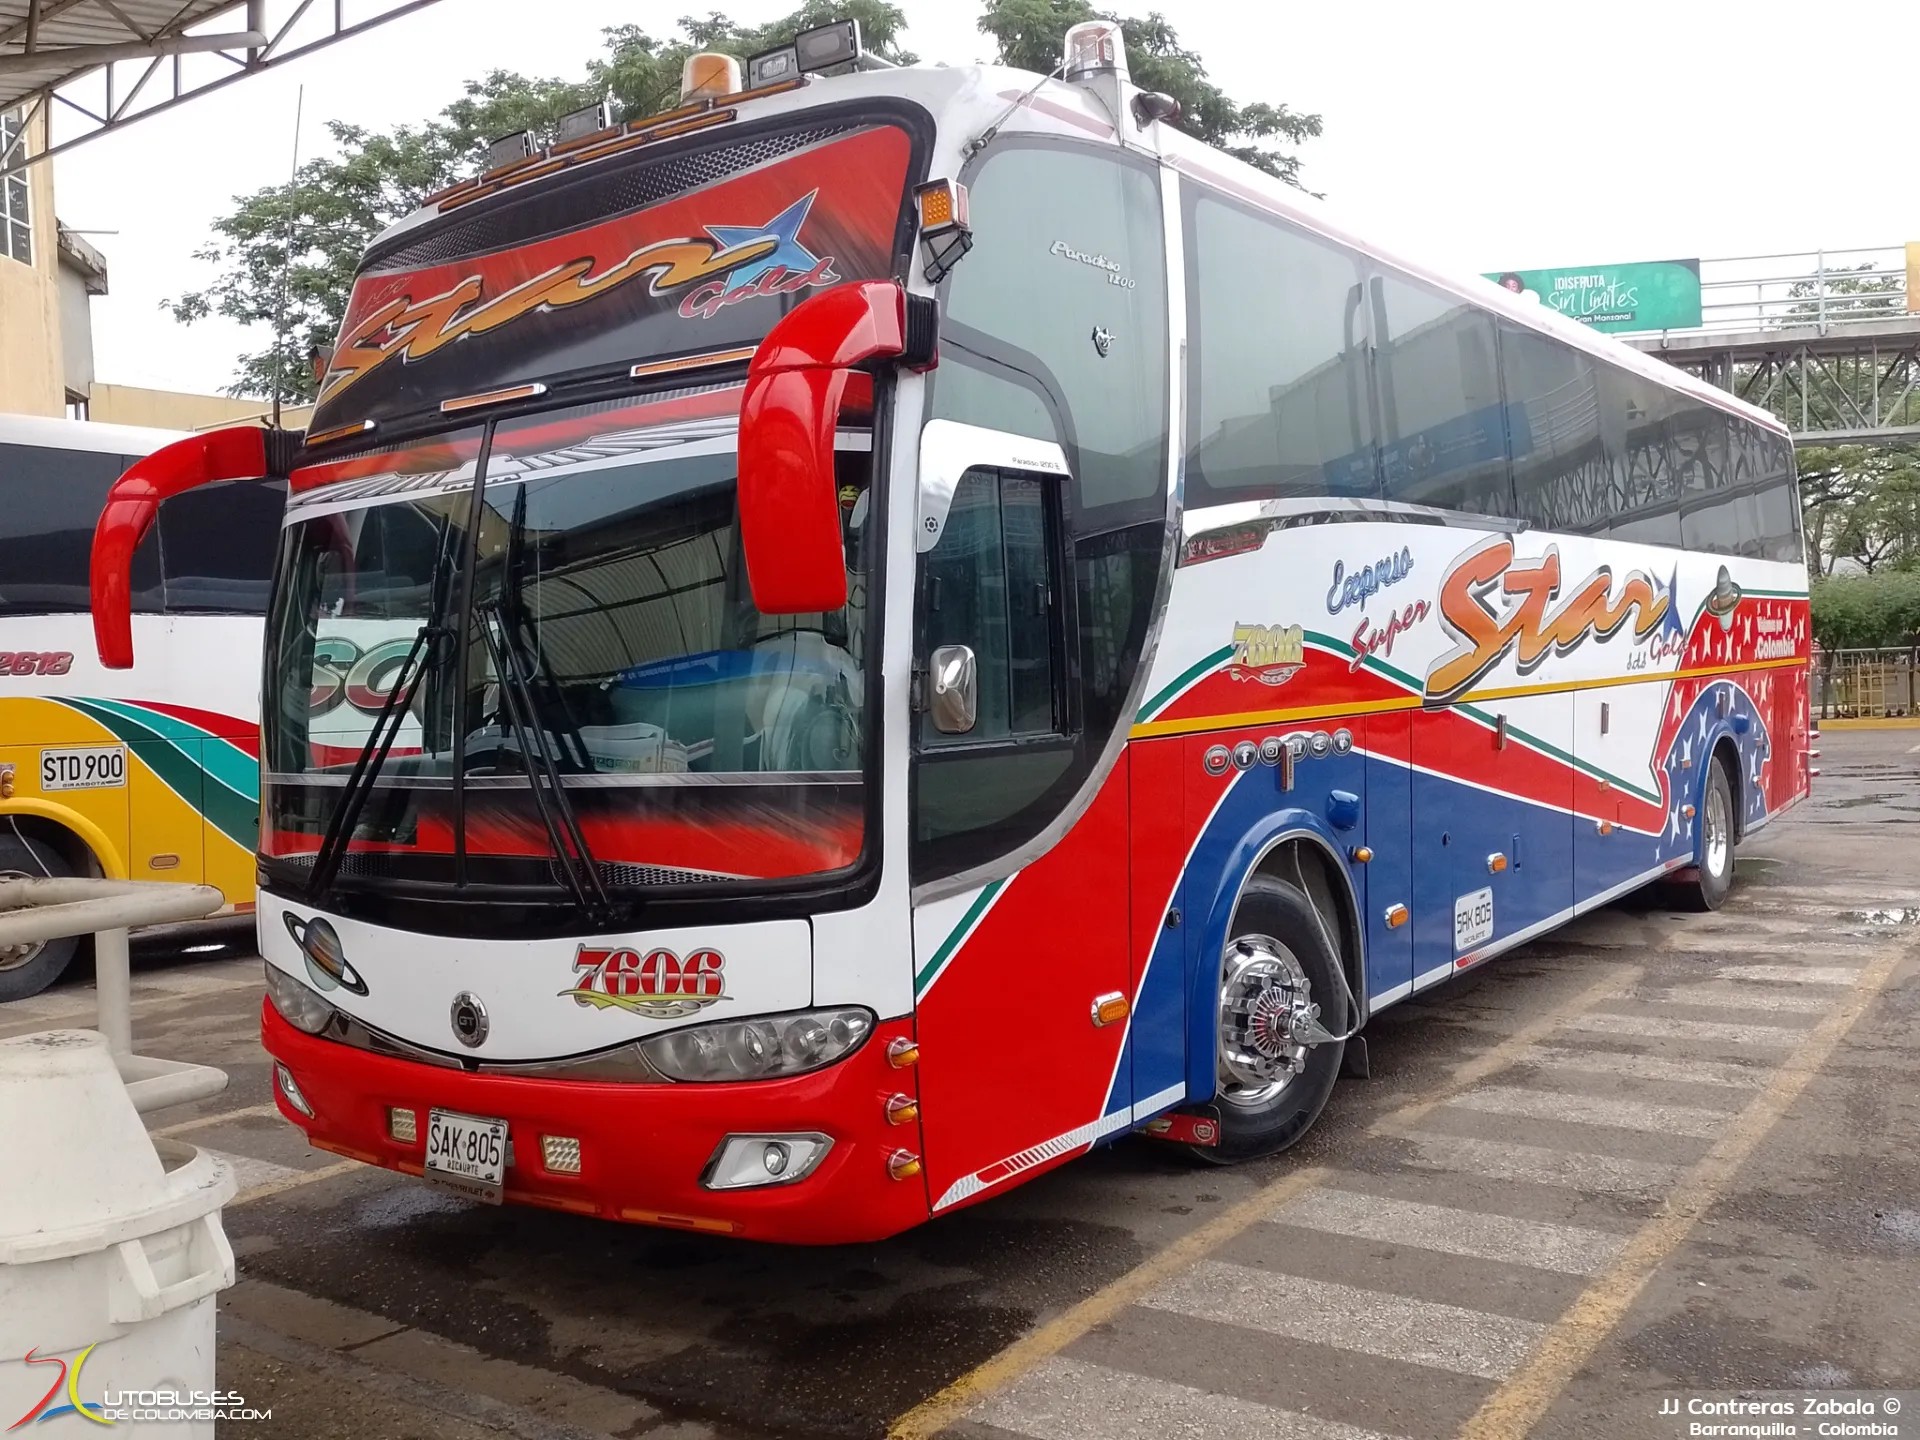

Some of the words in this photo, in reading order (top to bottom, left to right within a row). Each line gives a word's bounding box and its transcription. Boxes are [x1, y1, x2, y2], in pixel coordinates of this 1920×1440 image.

[1049, 240, 1120, 273] Paradiso
[678, 256, 841, 319] Gold
[1349, 599, 1431, 673] Super
[1422, 533, 1670, 711] Star
[0, 651, 74, 676] 2618
[1757, 634, 1796, 660] Colombia
[43, 756, 81, 782] STD
[85, 754, 123, 780] 900
[571, 942, 727, 1007] 7606
[458, 1015, 476, 1027] GT
